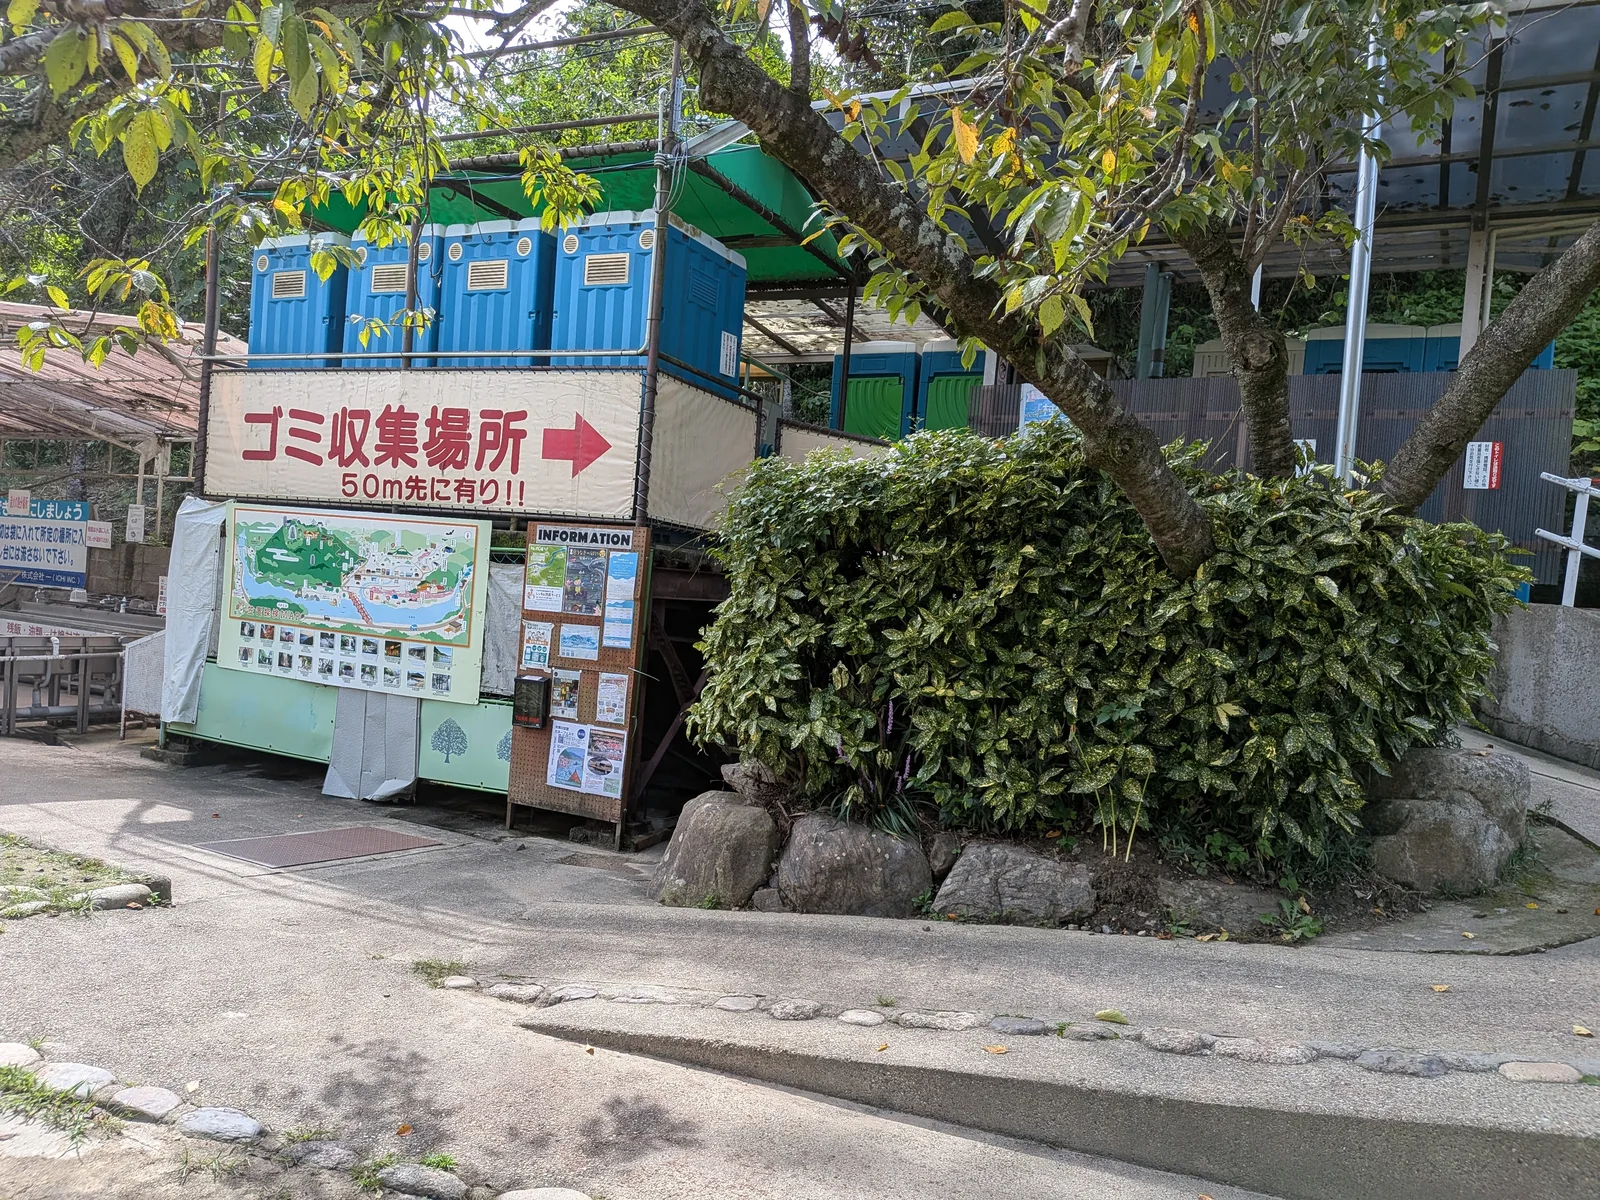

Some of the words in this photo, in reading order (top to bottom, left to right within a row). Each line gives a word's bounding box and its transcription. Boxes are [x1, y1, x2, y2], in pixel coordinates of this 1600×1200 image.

[242, 404, 528, 475] ゴミ収集場所
[341, 474, 526, 507] 50m先に有り!!
[538, 529, 631, 546] INFORMATION
[0, 544, 74, 566] 台には流さないで下さい。
